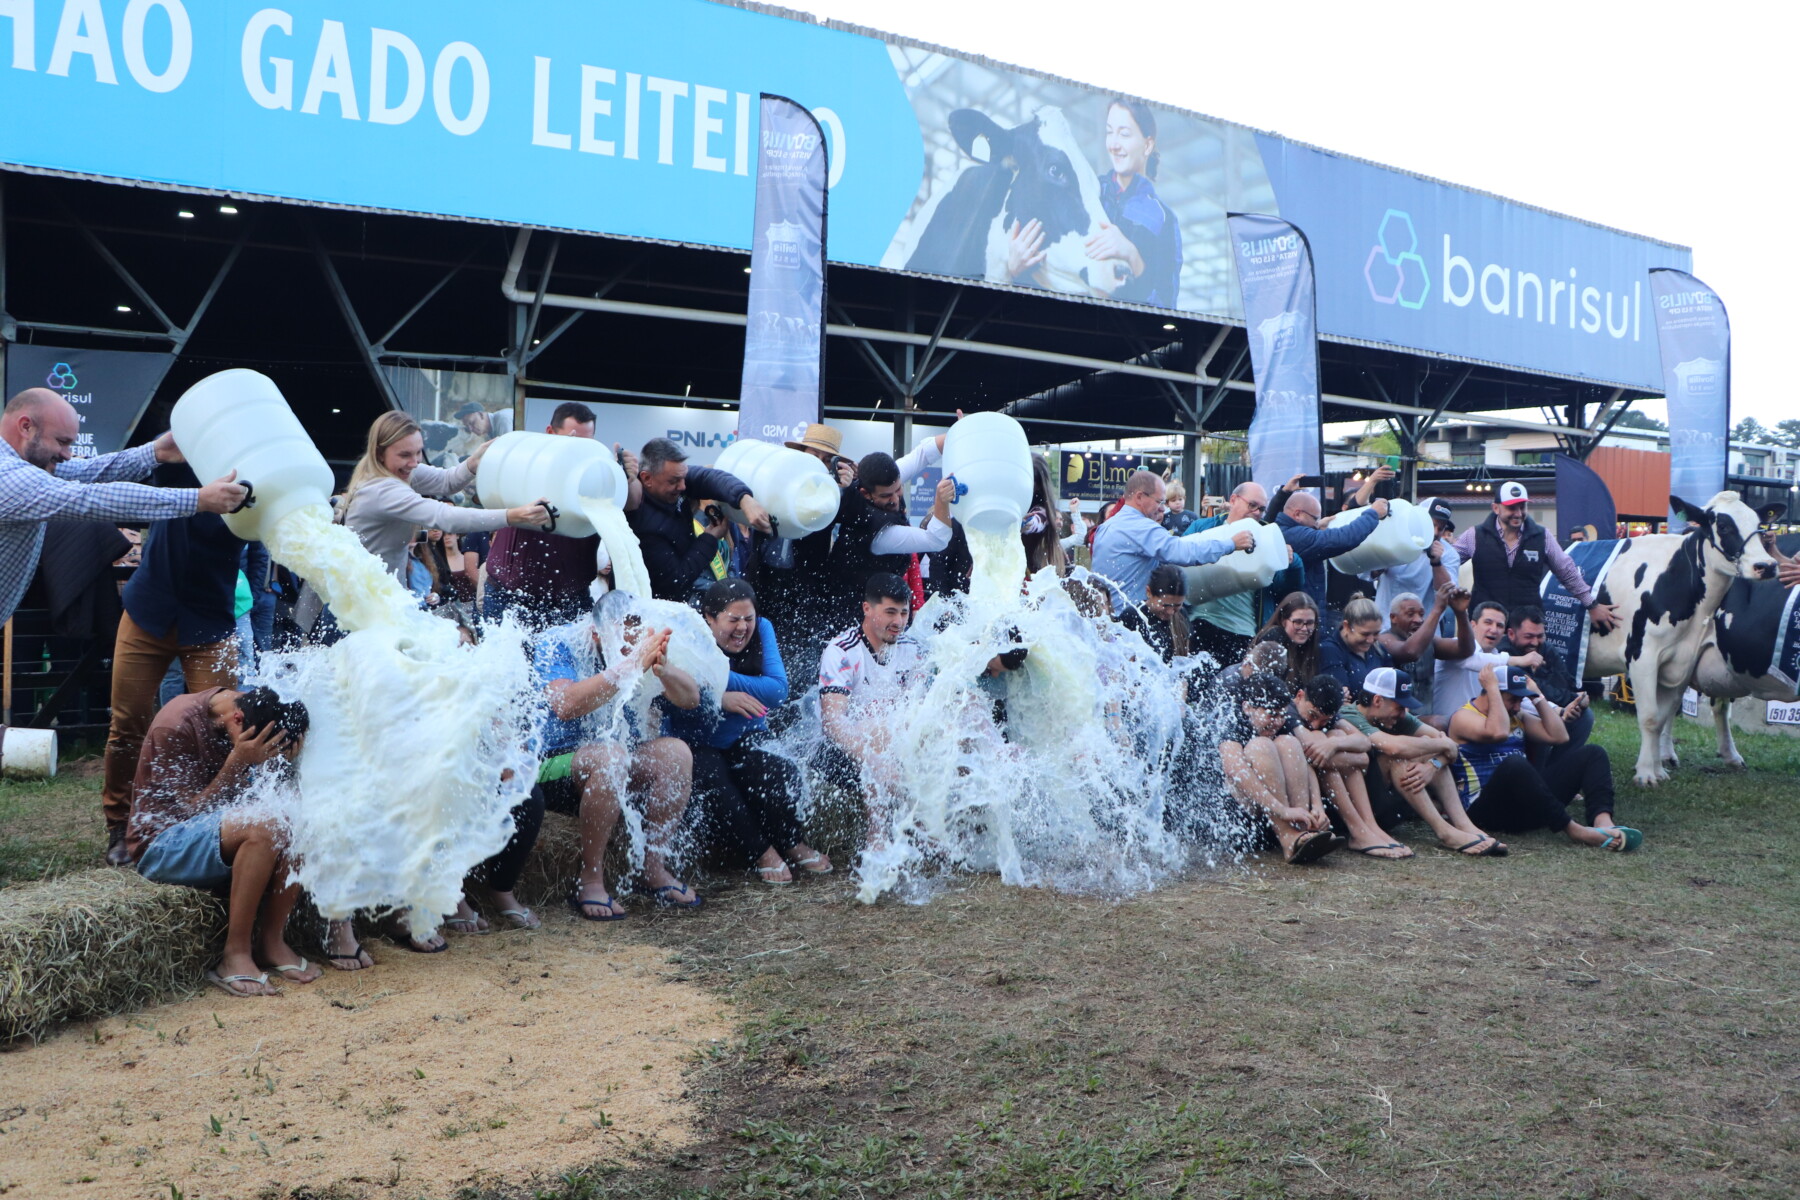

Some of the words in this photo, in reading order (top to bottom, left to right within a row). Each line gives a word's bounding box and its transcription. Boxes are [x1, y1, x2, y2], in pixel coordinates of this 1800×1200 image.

[241, 8, 491, 136] GADO
[531, 55, 846, 189] LEITEIO
[1443, 233, 1641, 342] banrisul
[62, 392, 92, 403] risul
[666, 429, 706, 448] PNI
[1545, 627, 1571, 638] JOVEM
[1769, 707, 1787, 720] (51)
